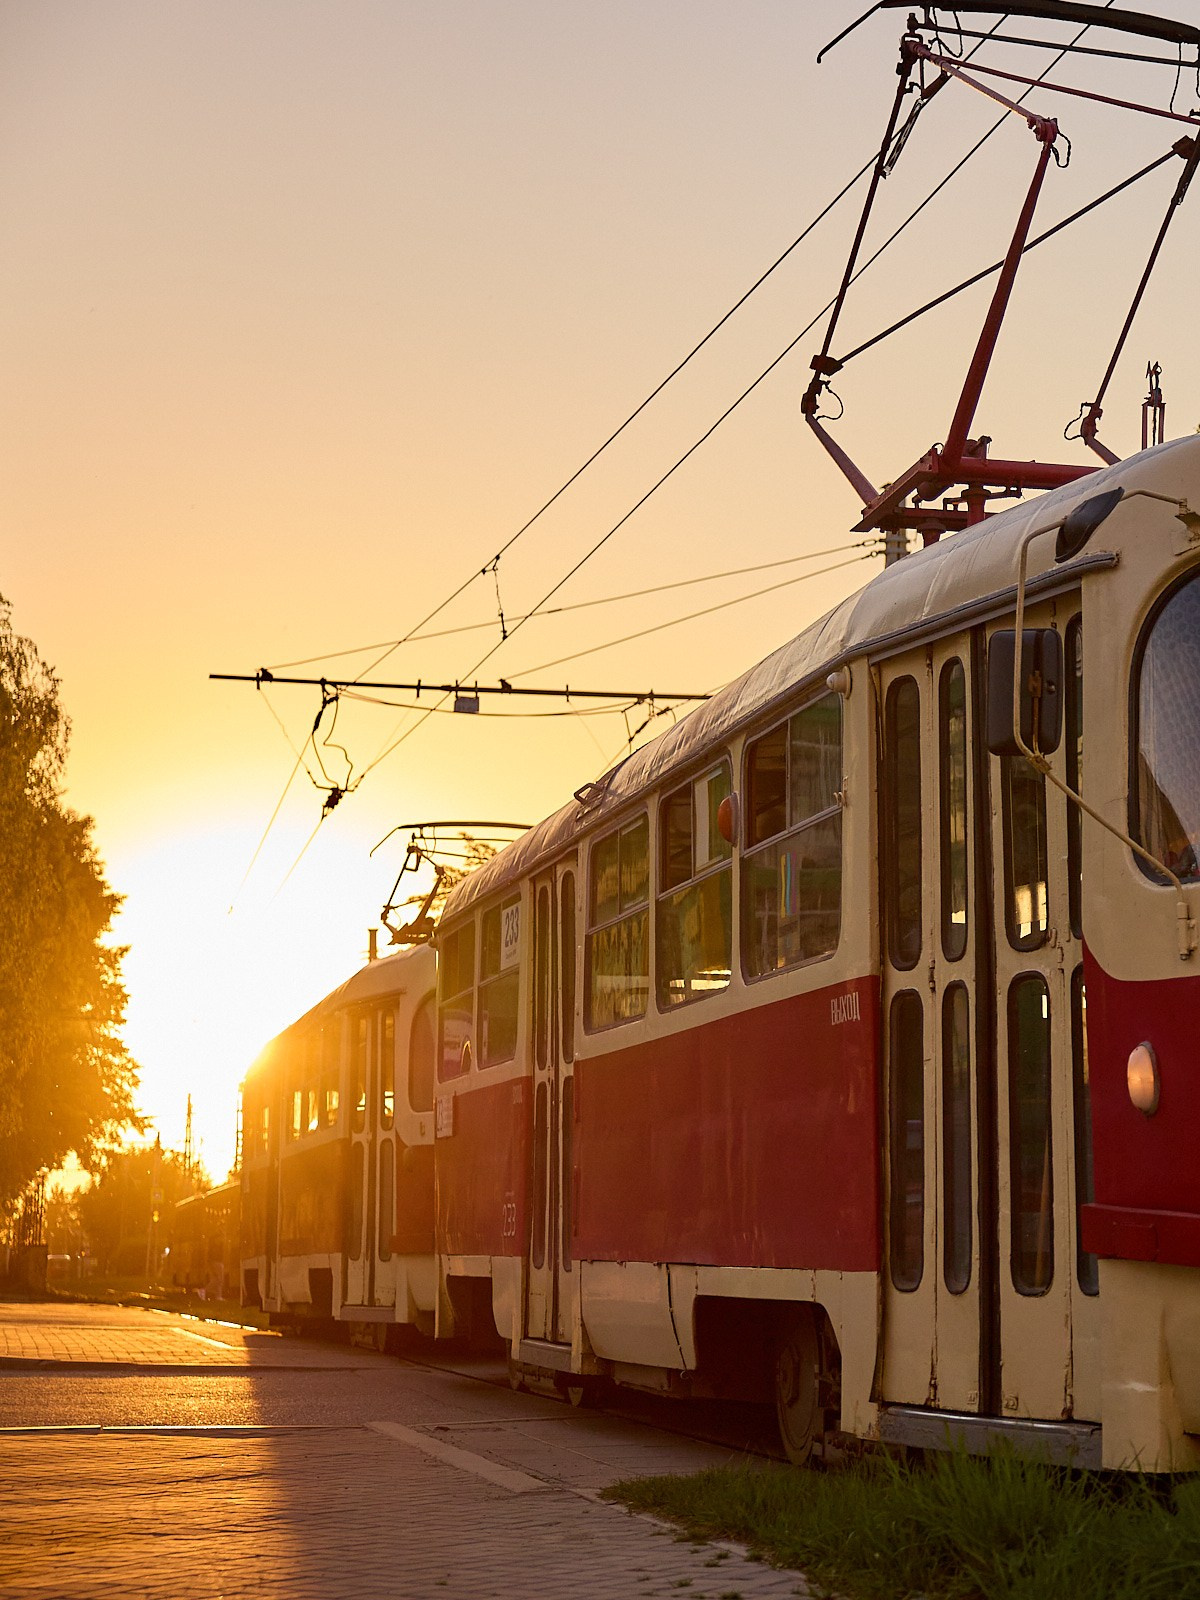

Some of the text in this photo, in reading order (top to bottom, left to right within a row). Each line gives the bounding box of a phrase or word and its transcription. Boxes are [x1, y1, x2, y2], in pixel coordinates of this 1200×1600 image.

[505, 906, 520, 948] 233
[830, 991, 861, 1026] ВЫХОД
[503, 1203, 517, 1237] 233
